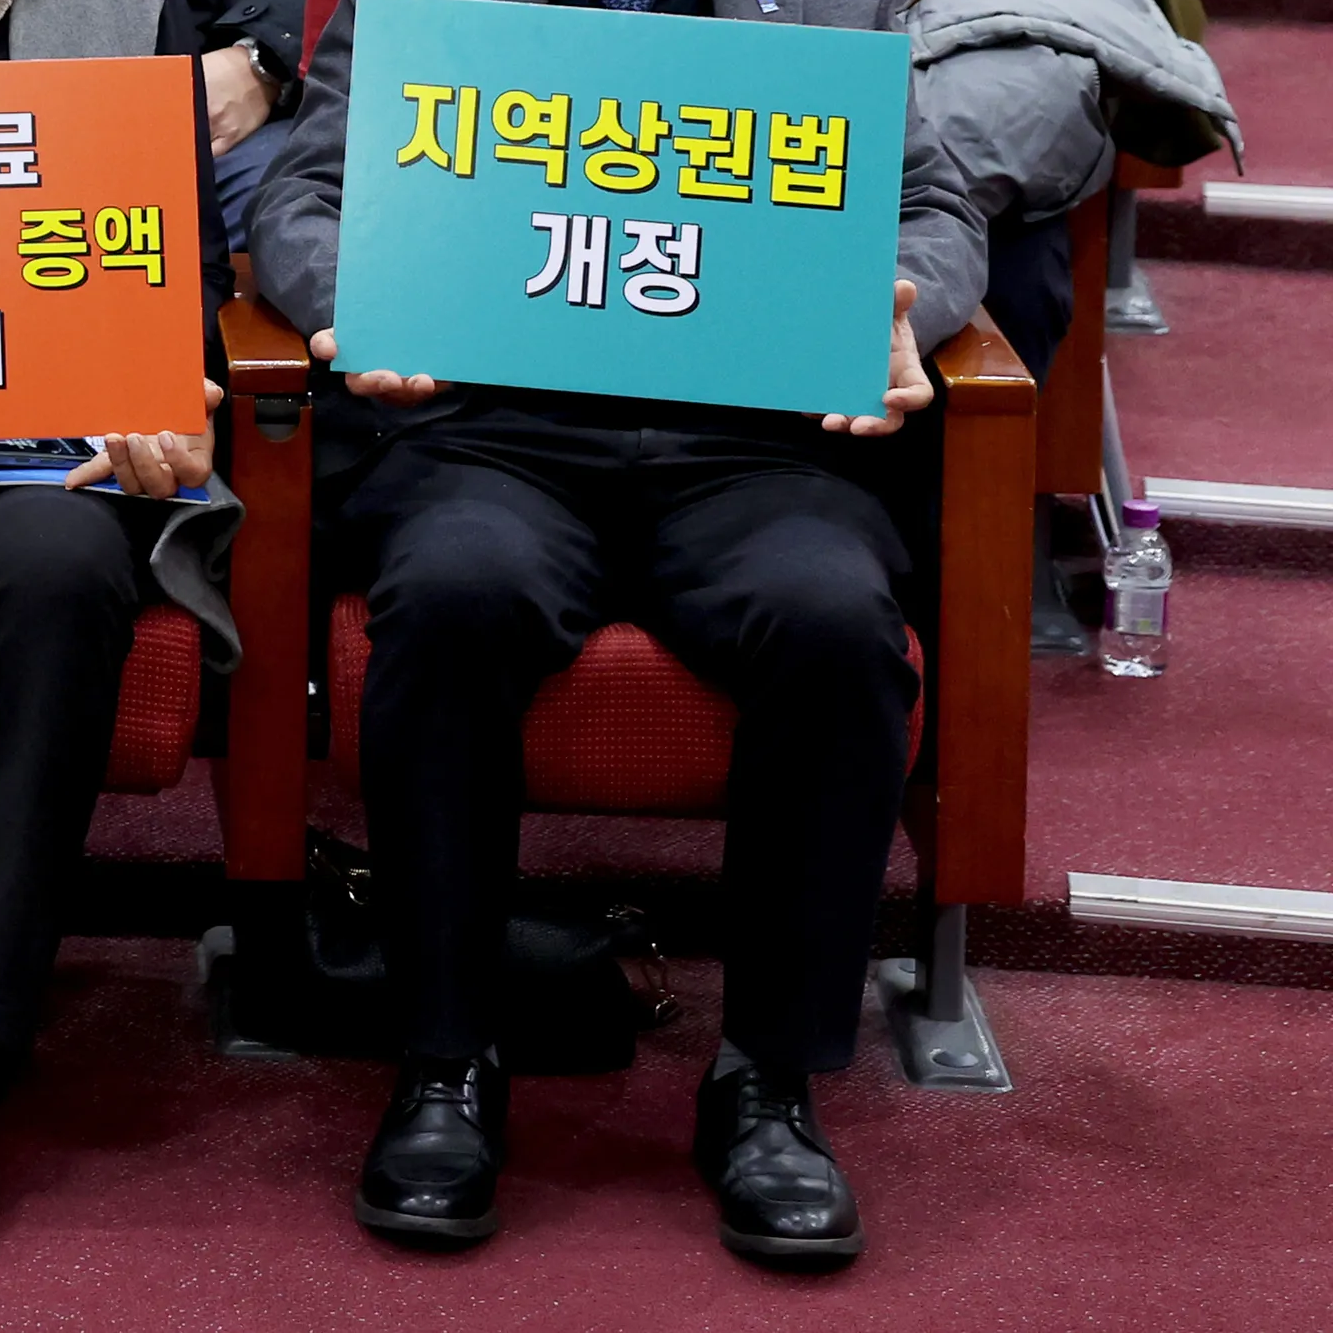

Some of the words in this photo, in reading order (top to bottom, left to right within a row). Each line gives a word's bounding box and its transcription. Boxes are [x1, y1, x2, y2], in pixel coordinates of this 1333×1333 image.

[396, 82, 849, 210] 지역상권법
[17, 205, 165, 289] 증액
[525, 212, 702, 316] 개정
